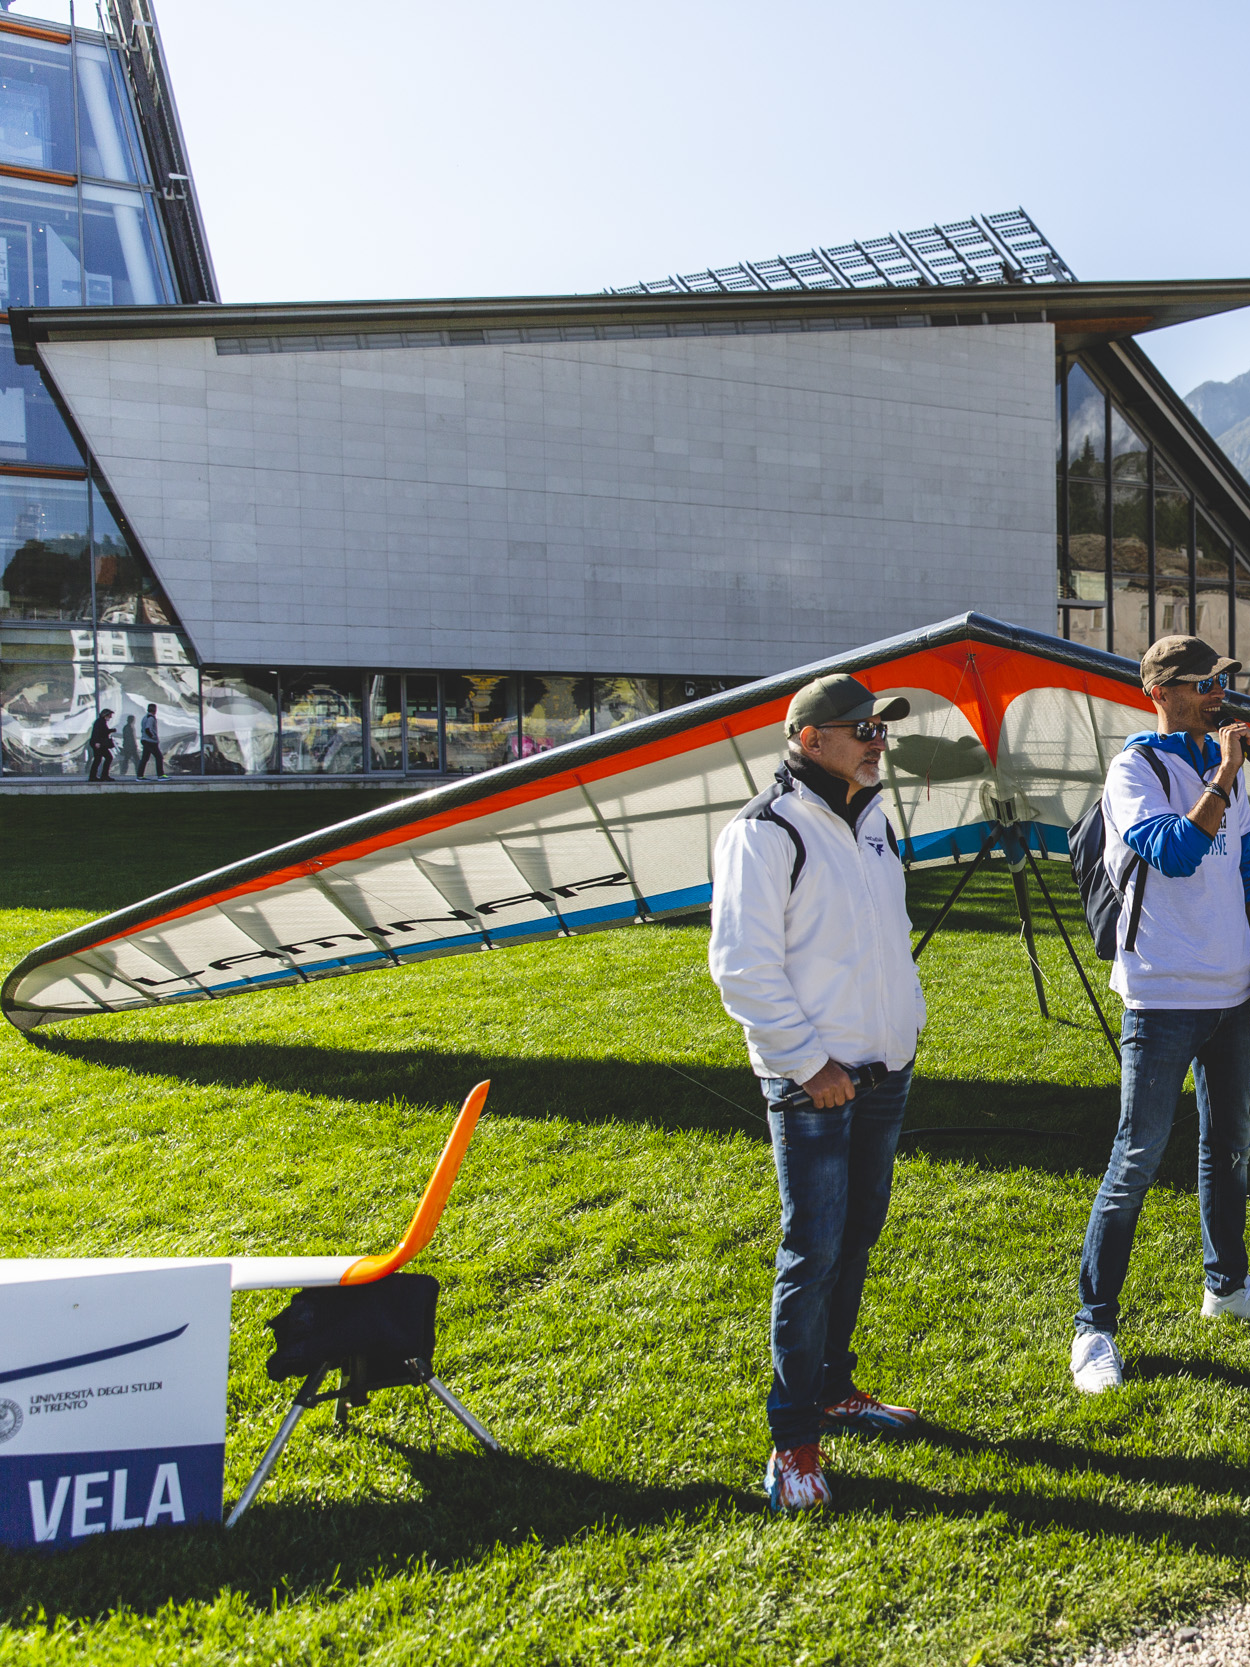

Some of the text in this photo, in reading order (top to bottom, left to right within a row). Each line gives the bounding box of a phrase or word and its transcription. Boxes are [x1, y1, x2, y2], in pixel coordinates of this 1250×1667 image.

[30, 1381, 163, 1404] UNIVERSITÀ DEGLI STUDI
[29, 1400, 88, 1415] DI TRENTO
[28, 1462, 186, 1543] VELA
